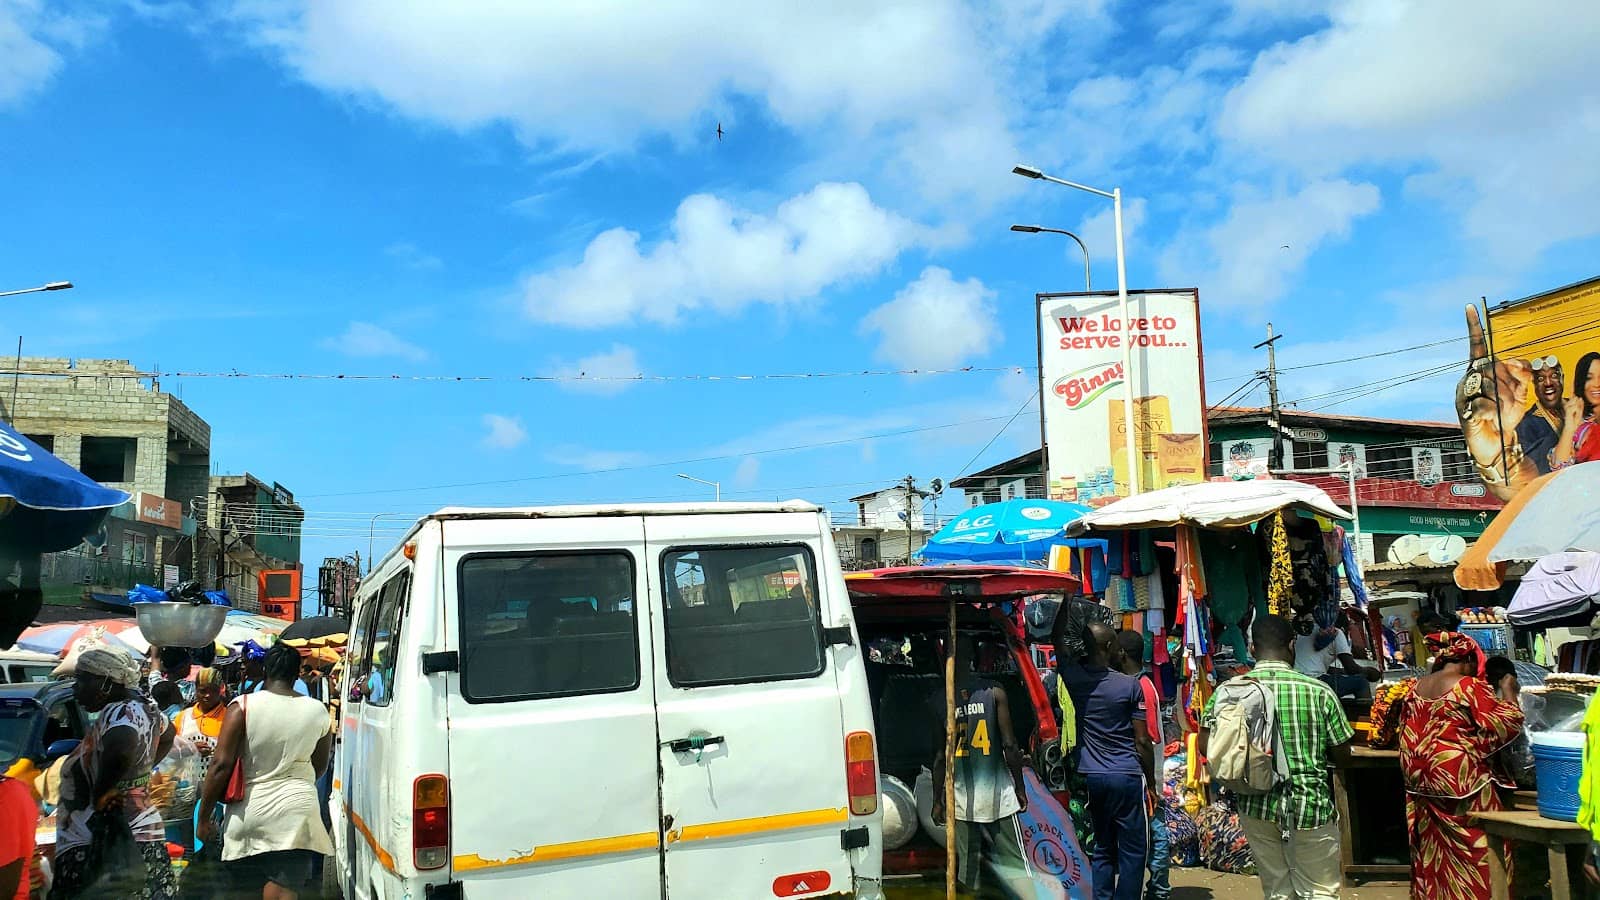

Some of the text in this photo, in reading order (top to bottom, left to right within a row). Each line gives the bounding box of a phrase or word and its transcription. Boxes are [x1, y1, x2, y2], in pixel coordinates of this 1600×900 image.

[1058, 314, 1177, 333] We love to
[1060, 334, 1120, 350] serve
[1117, 420, 1164, 434] GNNY
[955, 719, 991, 757] 24
[1037, 822, 1064, 841] PACK
